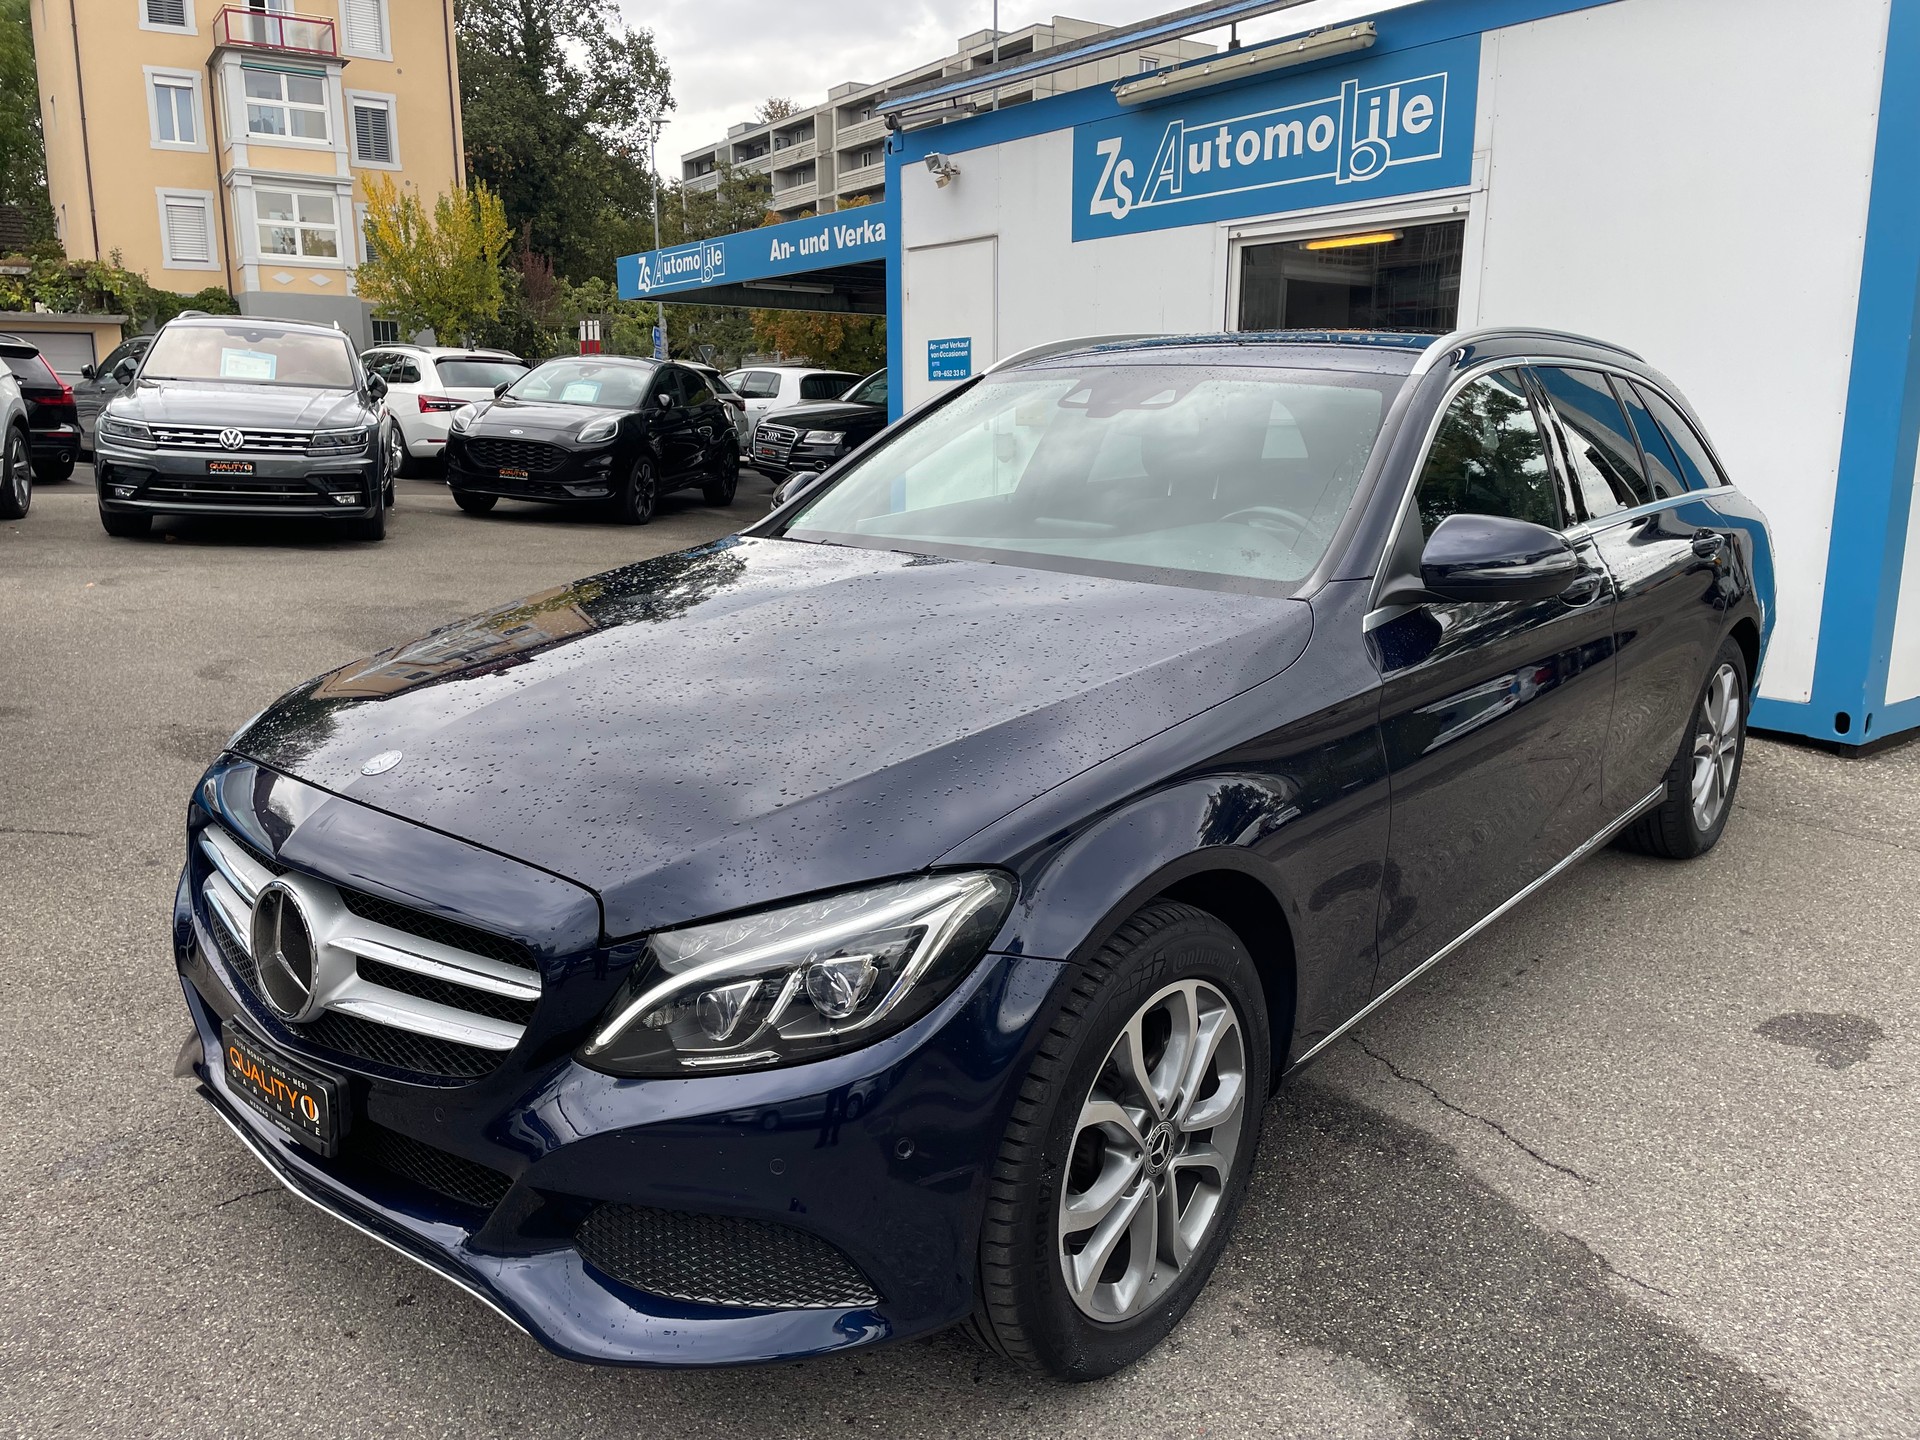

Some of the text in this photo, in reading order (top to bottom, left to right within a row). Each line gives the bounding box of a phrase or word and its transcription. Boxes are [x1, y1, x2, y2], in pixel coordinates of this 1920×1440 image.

[1089, 78, 1434, 220] Zs Automobile
[637, 241, 724, 293] Zs Automobile
[769, 219, 886, 262] An- und Verka
[229, 1046, 298, 1109] QUALITY
[232, 1069, 320, 1136] GARANTIE
